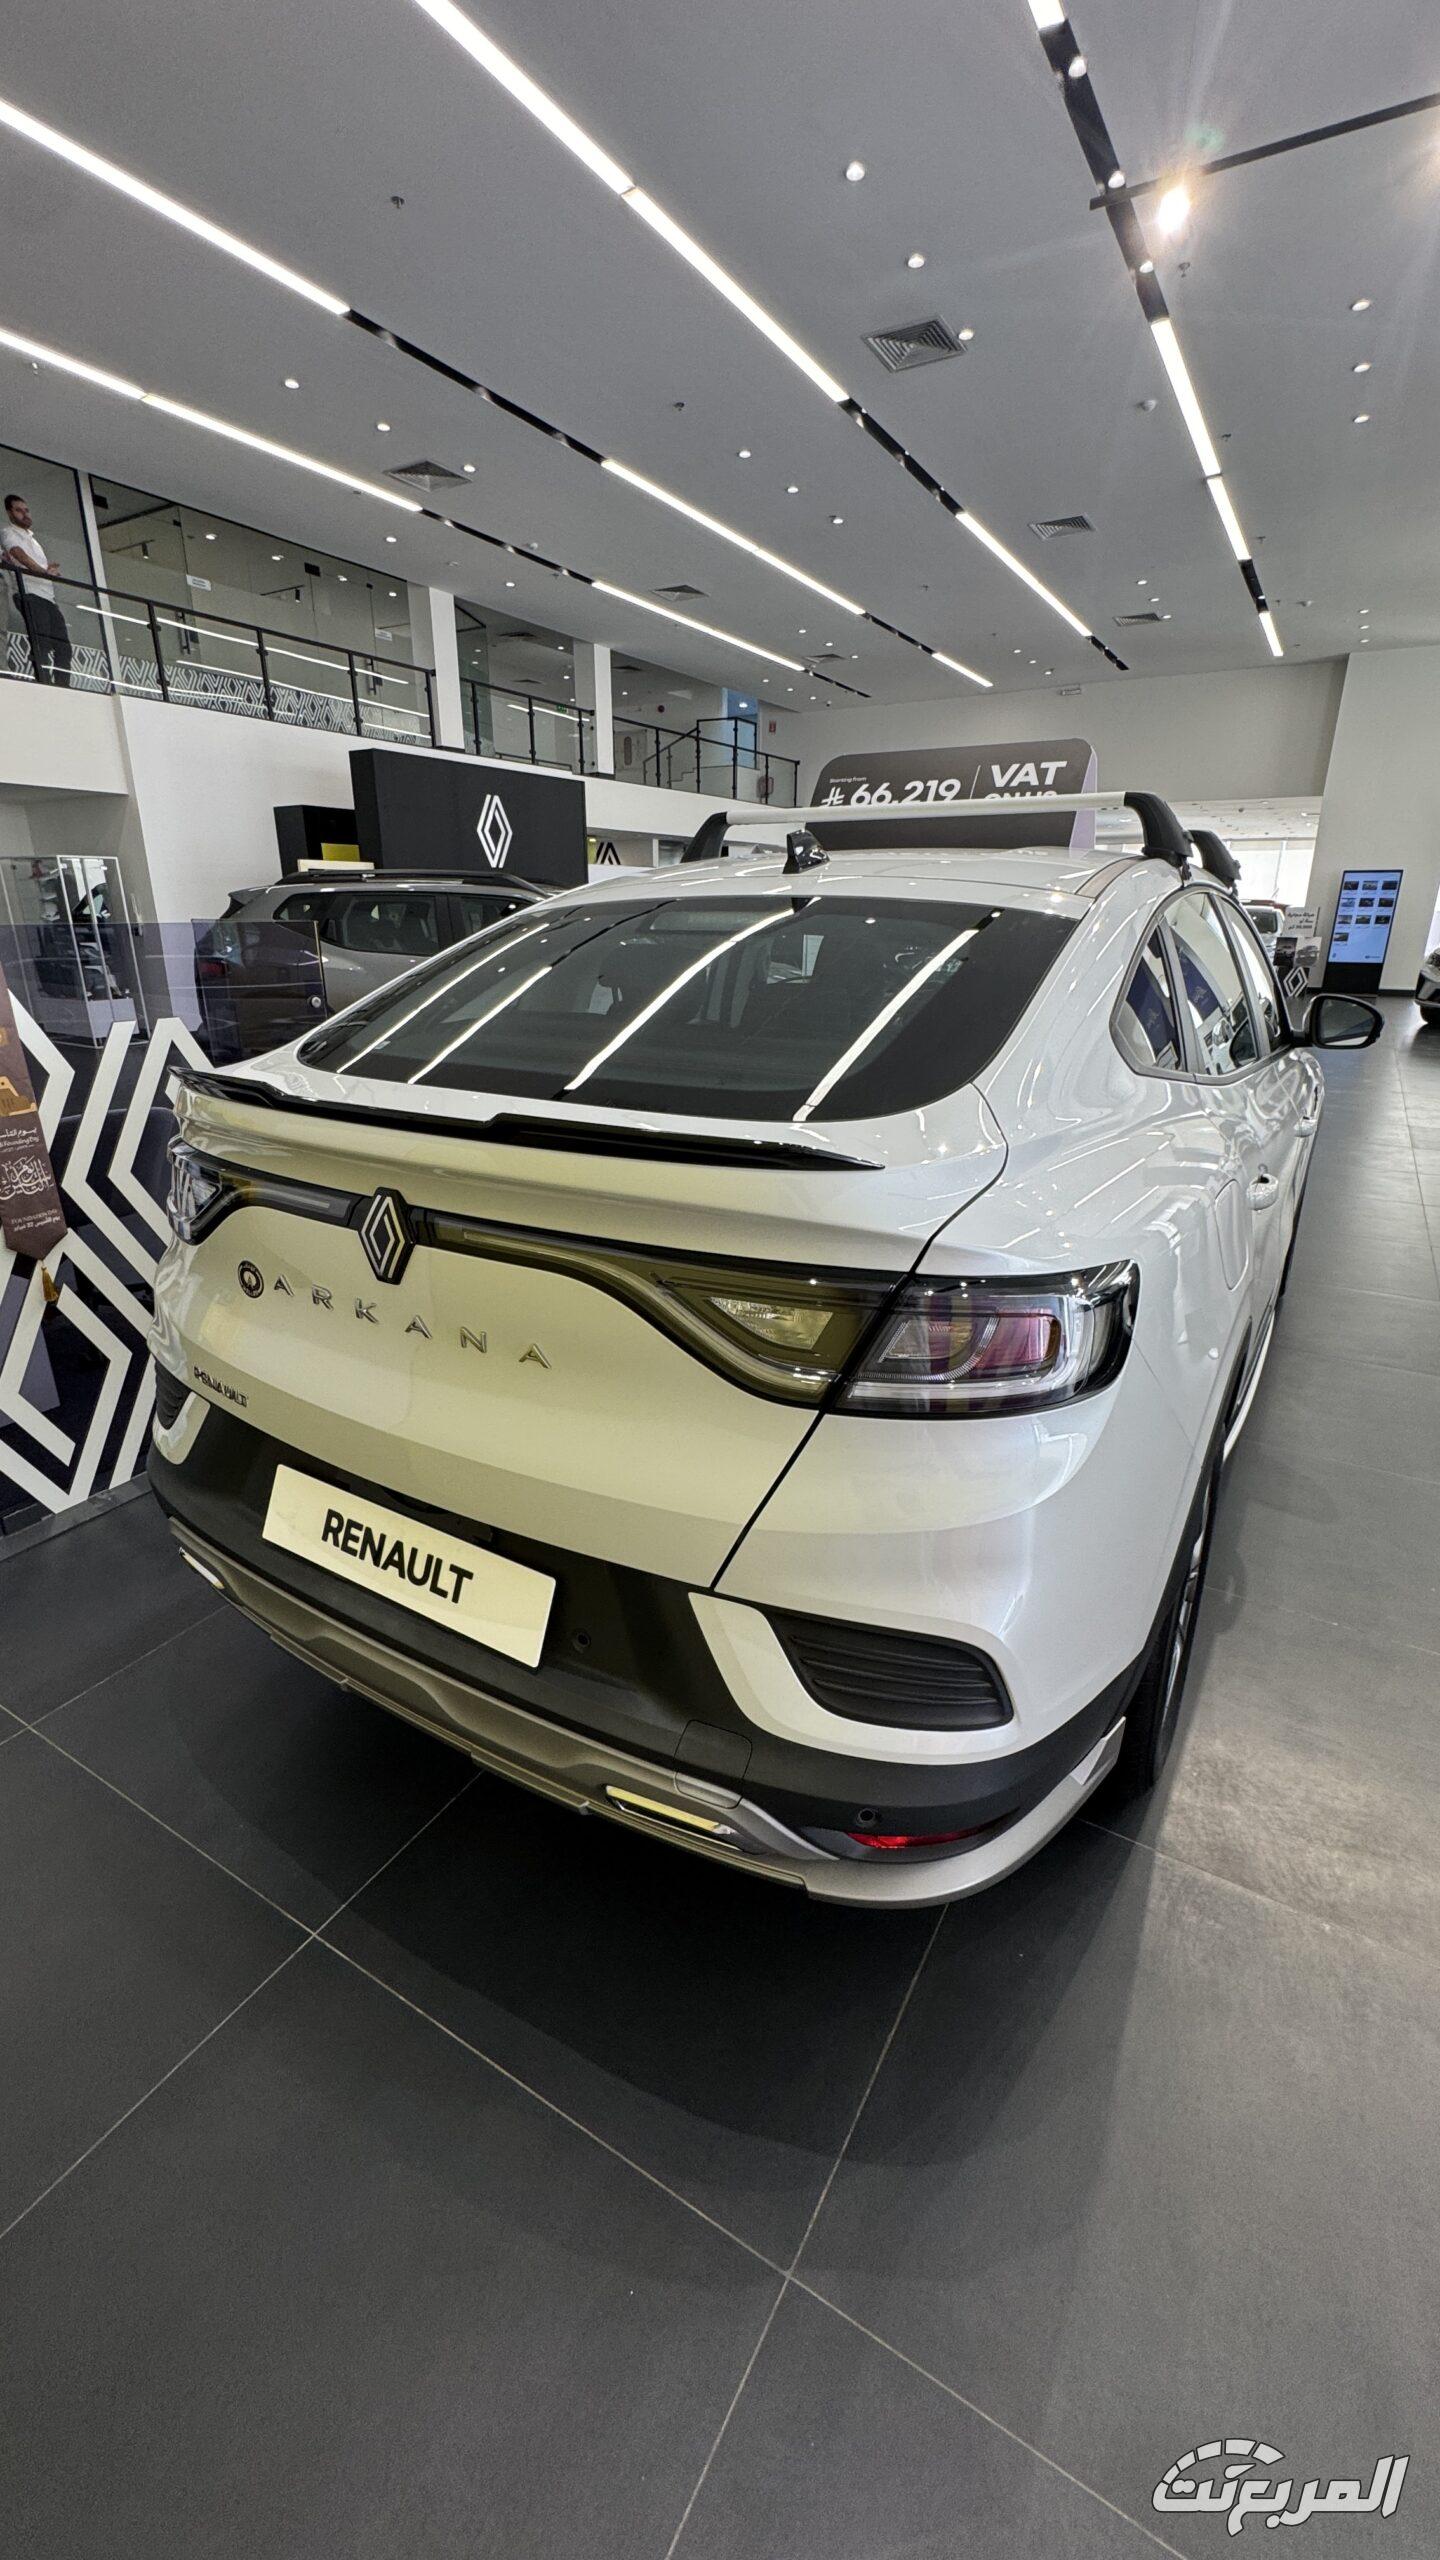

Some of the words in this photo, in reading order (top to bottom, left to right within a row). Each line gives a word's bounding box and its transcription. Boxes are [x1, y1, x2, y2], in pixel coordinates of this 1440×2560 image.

[991, 760, 1068, 788] VAT
[273, 1273, 552, 1369] ARKANA
[321, 1508, 474, 1605] RENAULT
